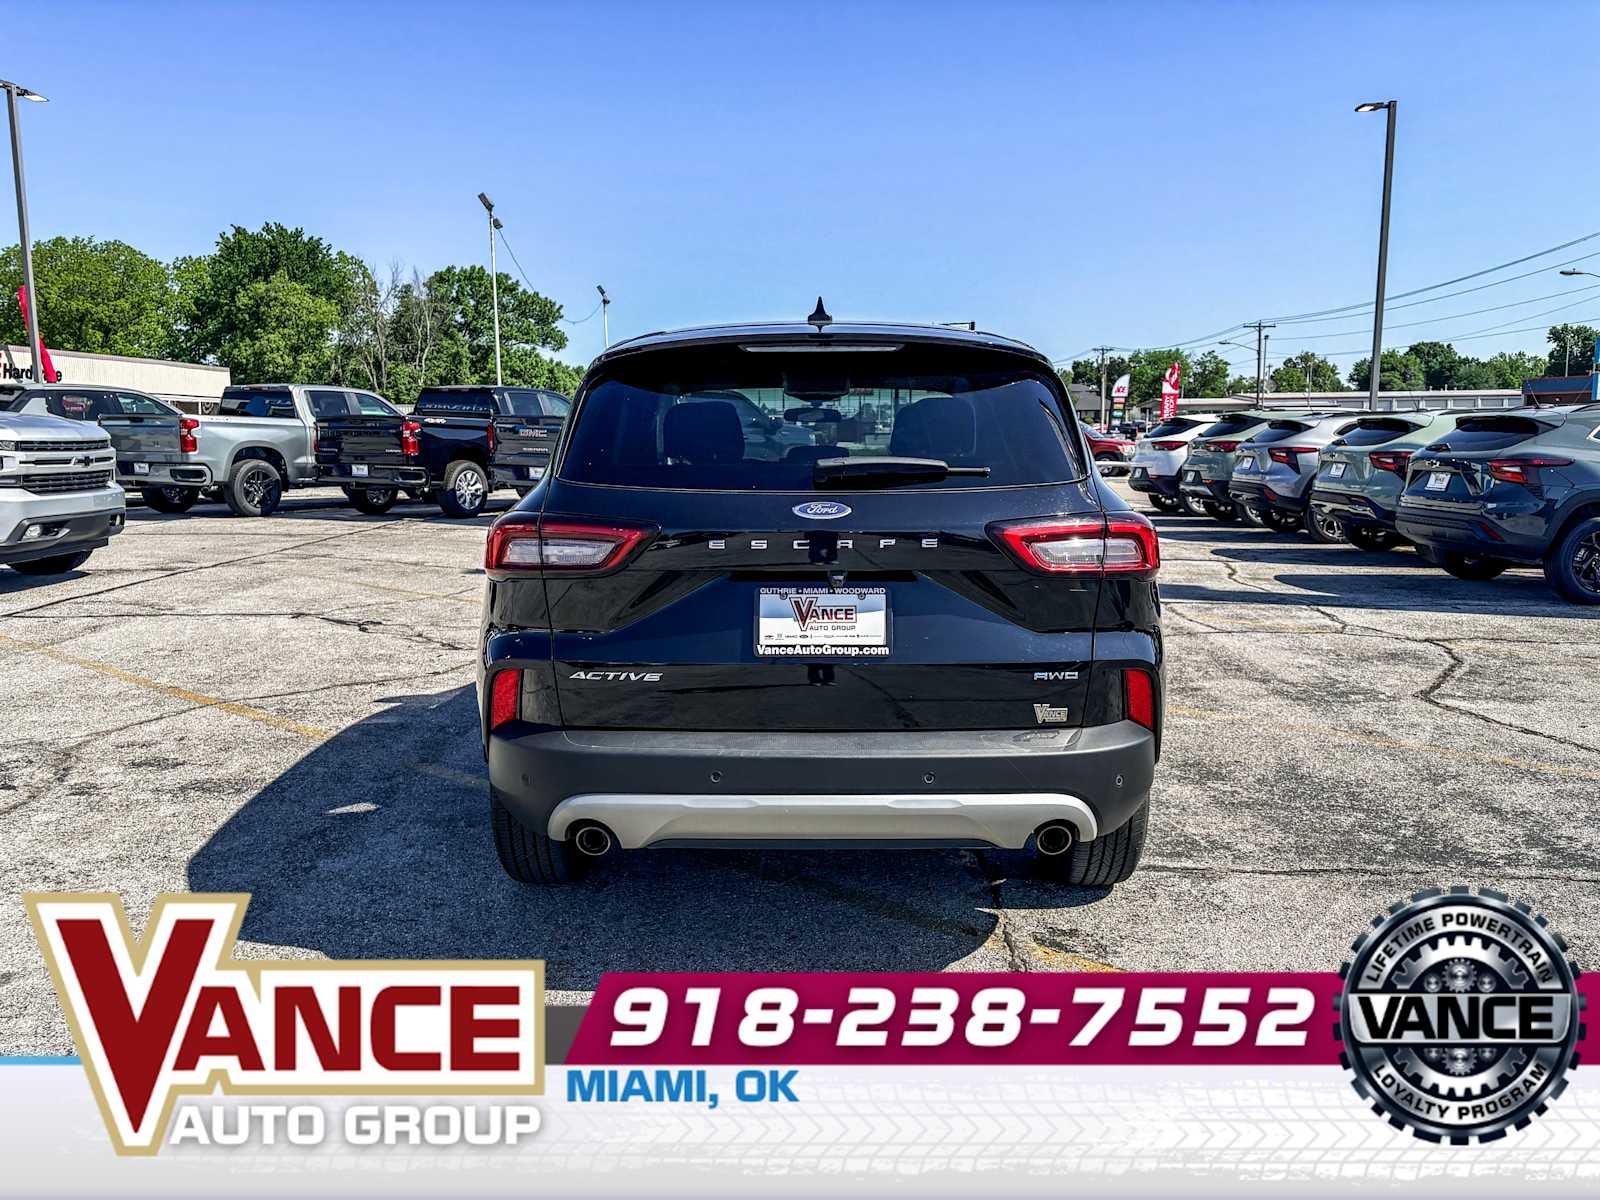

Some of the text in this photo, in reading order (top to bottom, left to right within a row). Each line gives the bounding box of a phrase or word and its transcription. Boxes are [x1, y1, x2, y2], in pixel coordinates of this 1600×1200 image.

[807, 503, 838, 514] Ford
[708, 538, 938, 549] ESCAPE
[760, 587, 886, 595] GUTHRIE MIAMI WOODWARD
[791, 599, 855, 629] VANCE
[757, 644, 890, 656] VanceAutoGroup.com
[569, 671, 664, 682] ACTIVE
[1033, 671, 1079, 681] AWD
